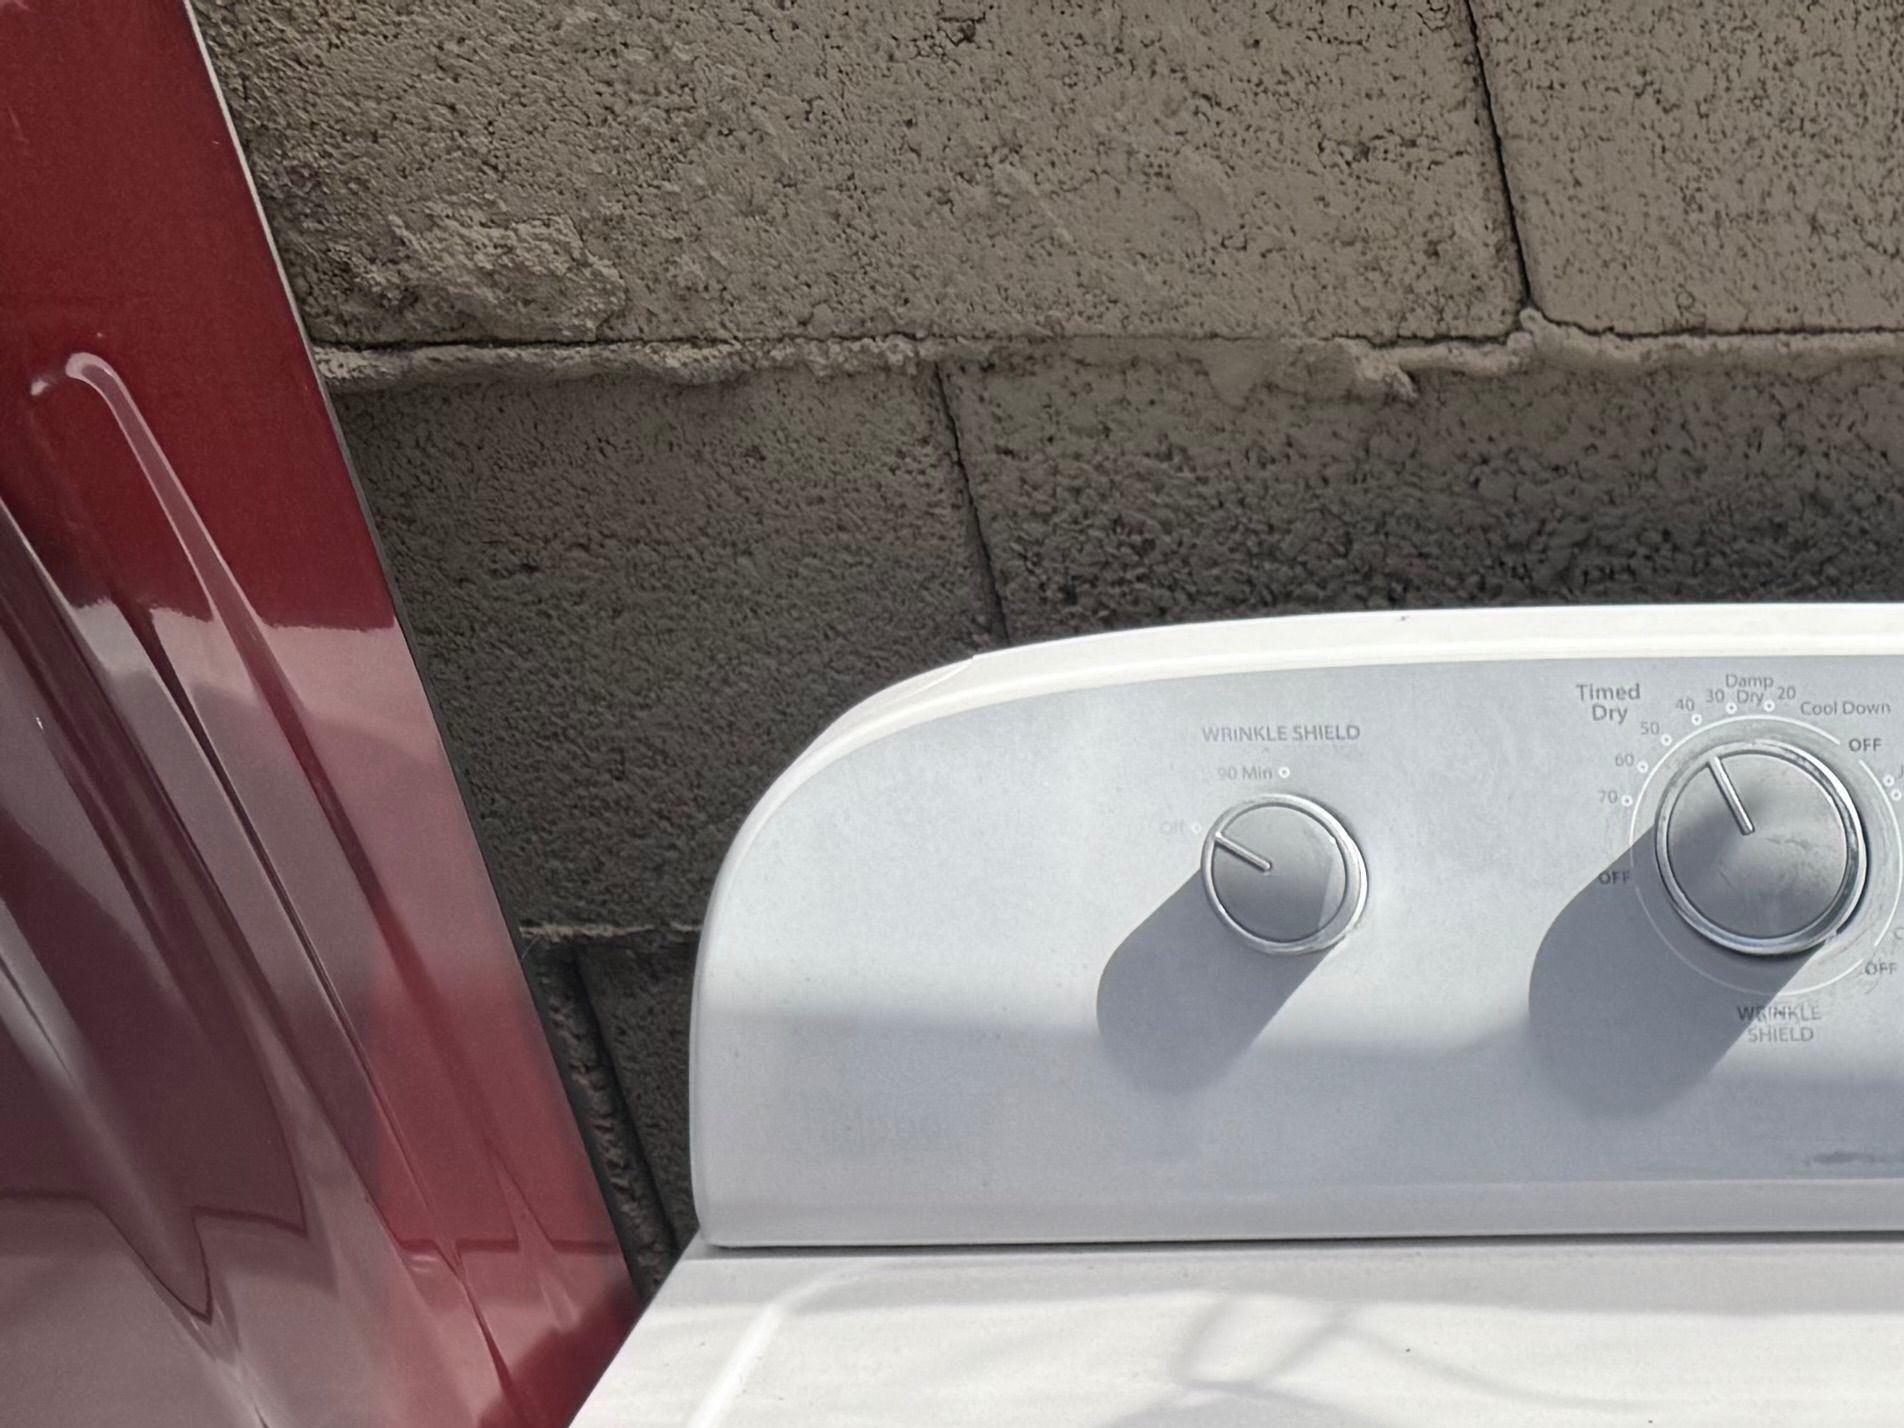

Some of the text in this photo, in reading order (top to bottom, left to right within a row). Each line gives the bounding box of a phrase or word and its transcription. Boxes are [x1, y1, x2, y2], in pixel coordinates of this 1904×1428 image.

[1725, 673, 1774, 690] Damp
[1576, 683, 1641, 700] Timed
[1706, 689, 1725, 703] 30
[1737, 690, 1764, 706] Dry
[1777, 686, 1796, 700] 20
[1675, 698, 1695, 711] 40
[1800, 701, 1891, 716] Cool Down
[1592, 705, 1628, 725] Dry
[1203, 724, 1360, 742] WRINKLE SHIELD
[1640, 722, 1660, 735] 50
[1849, 738, 1882, 752] OFF
[1615, 754, 1634, 767] 60
[1243, 766, 1273, 780] Min
[1598, 790, 1618, 804] 70
[1599, 871, 1631, 885] OFF
[1864, 962, 1897, 976] OFF
[1737, 1005, 1821, 1022] WRINKLE
[1748, 1027, 1814, 1043] SHIELD
